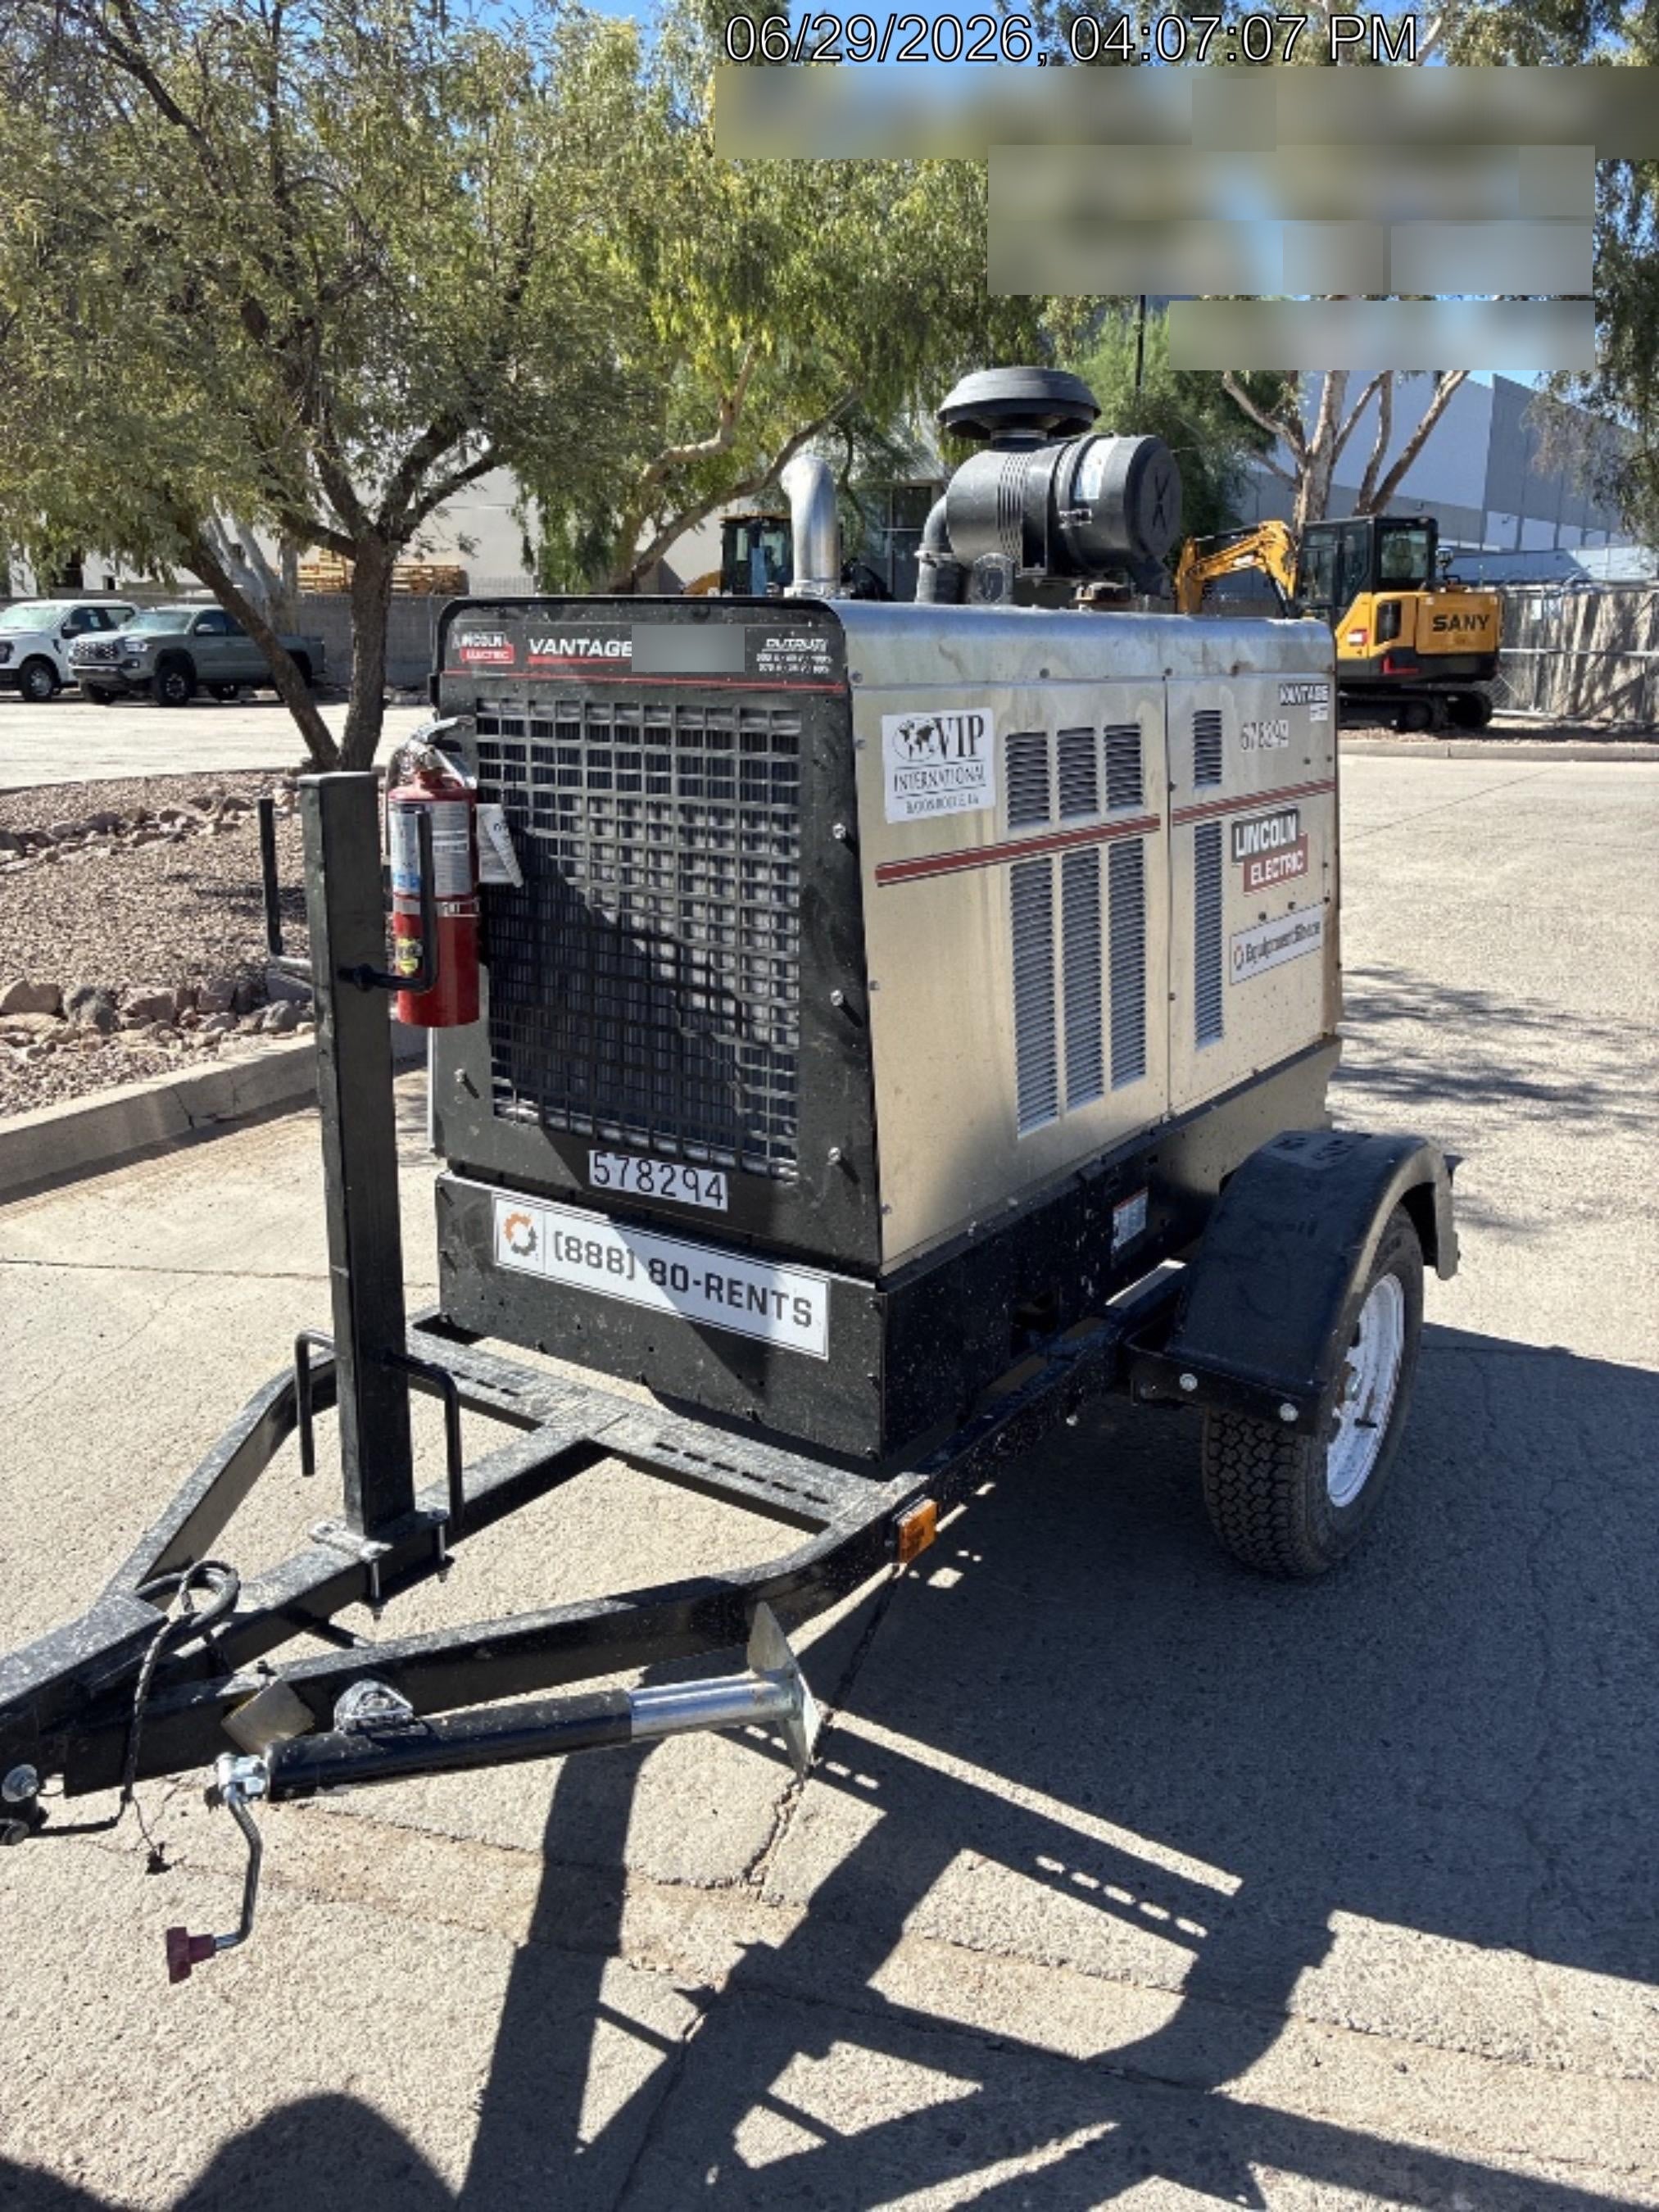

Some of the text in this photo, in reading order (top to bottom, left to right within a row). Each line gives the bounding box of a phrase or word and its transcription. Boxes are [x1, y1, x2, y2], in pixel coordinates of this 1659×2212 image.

[1434, 615, 1489, 632] SANY
[932, 714, 984, 759] VIP
[1235, 811, 1298, 858] LINCOLN
[1250, 850, 1304, 886] ELECTRIC
[594, 1152, 723, 1207] 578294
[648, 1258, 813, 1328] 80-RENTS
